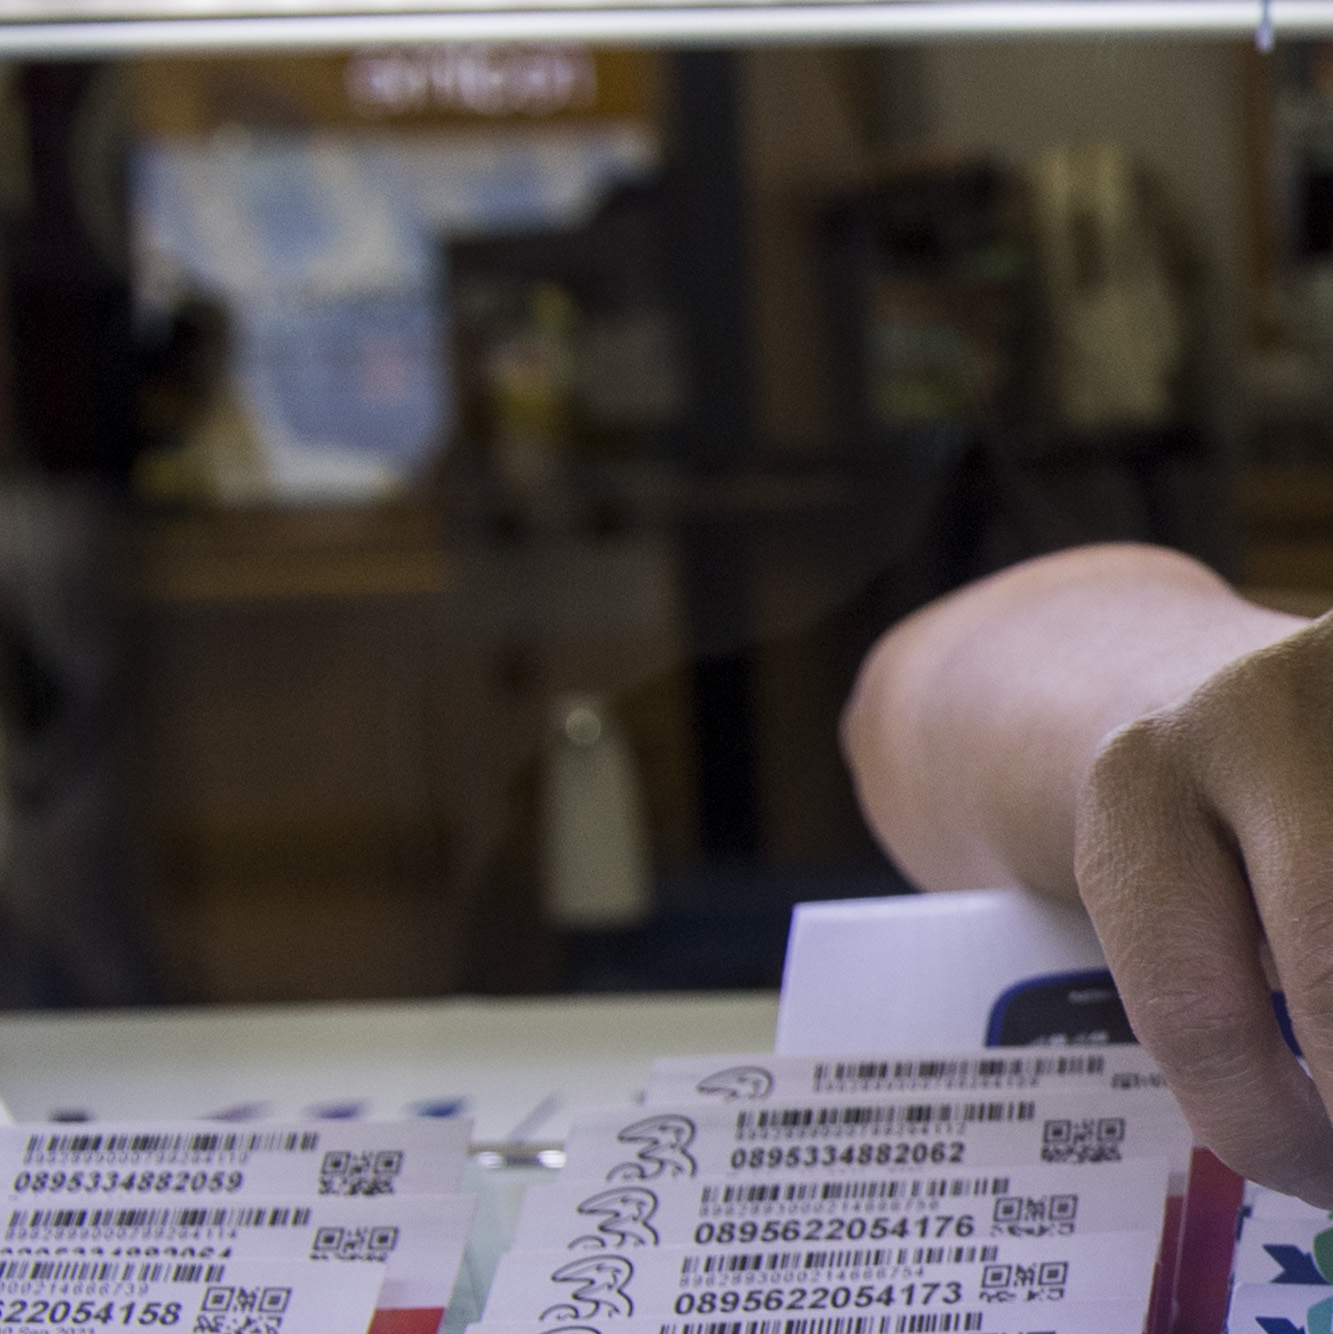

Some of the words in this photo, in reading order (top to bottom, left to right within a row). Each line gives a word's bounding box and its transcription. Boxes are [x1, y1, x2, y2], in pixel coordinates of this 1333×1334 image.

[730, 1140, 966, 1170] 0895334882062
[12, 1170, 244, 1194] 0895334882059
[694, 1214, 975, 1245] 0895622054176
[0, 1299, 183, 1326] 22054158
[674, 1281, 964, 1316] 0895622054173
